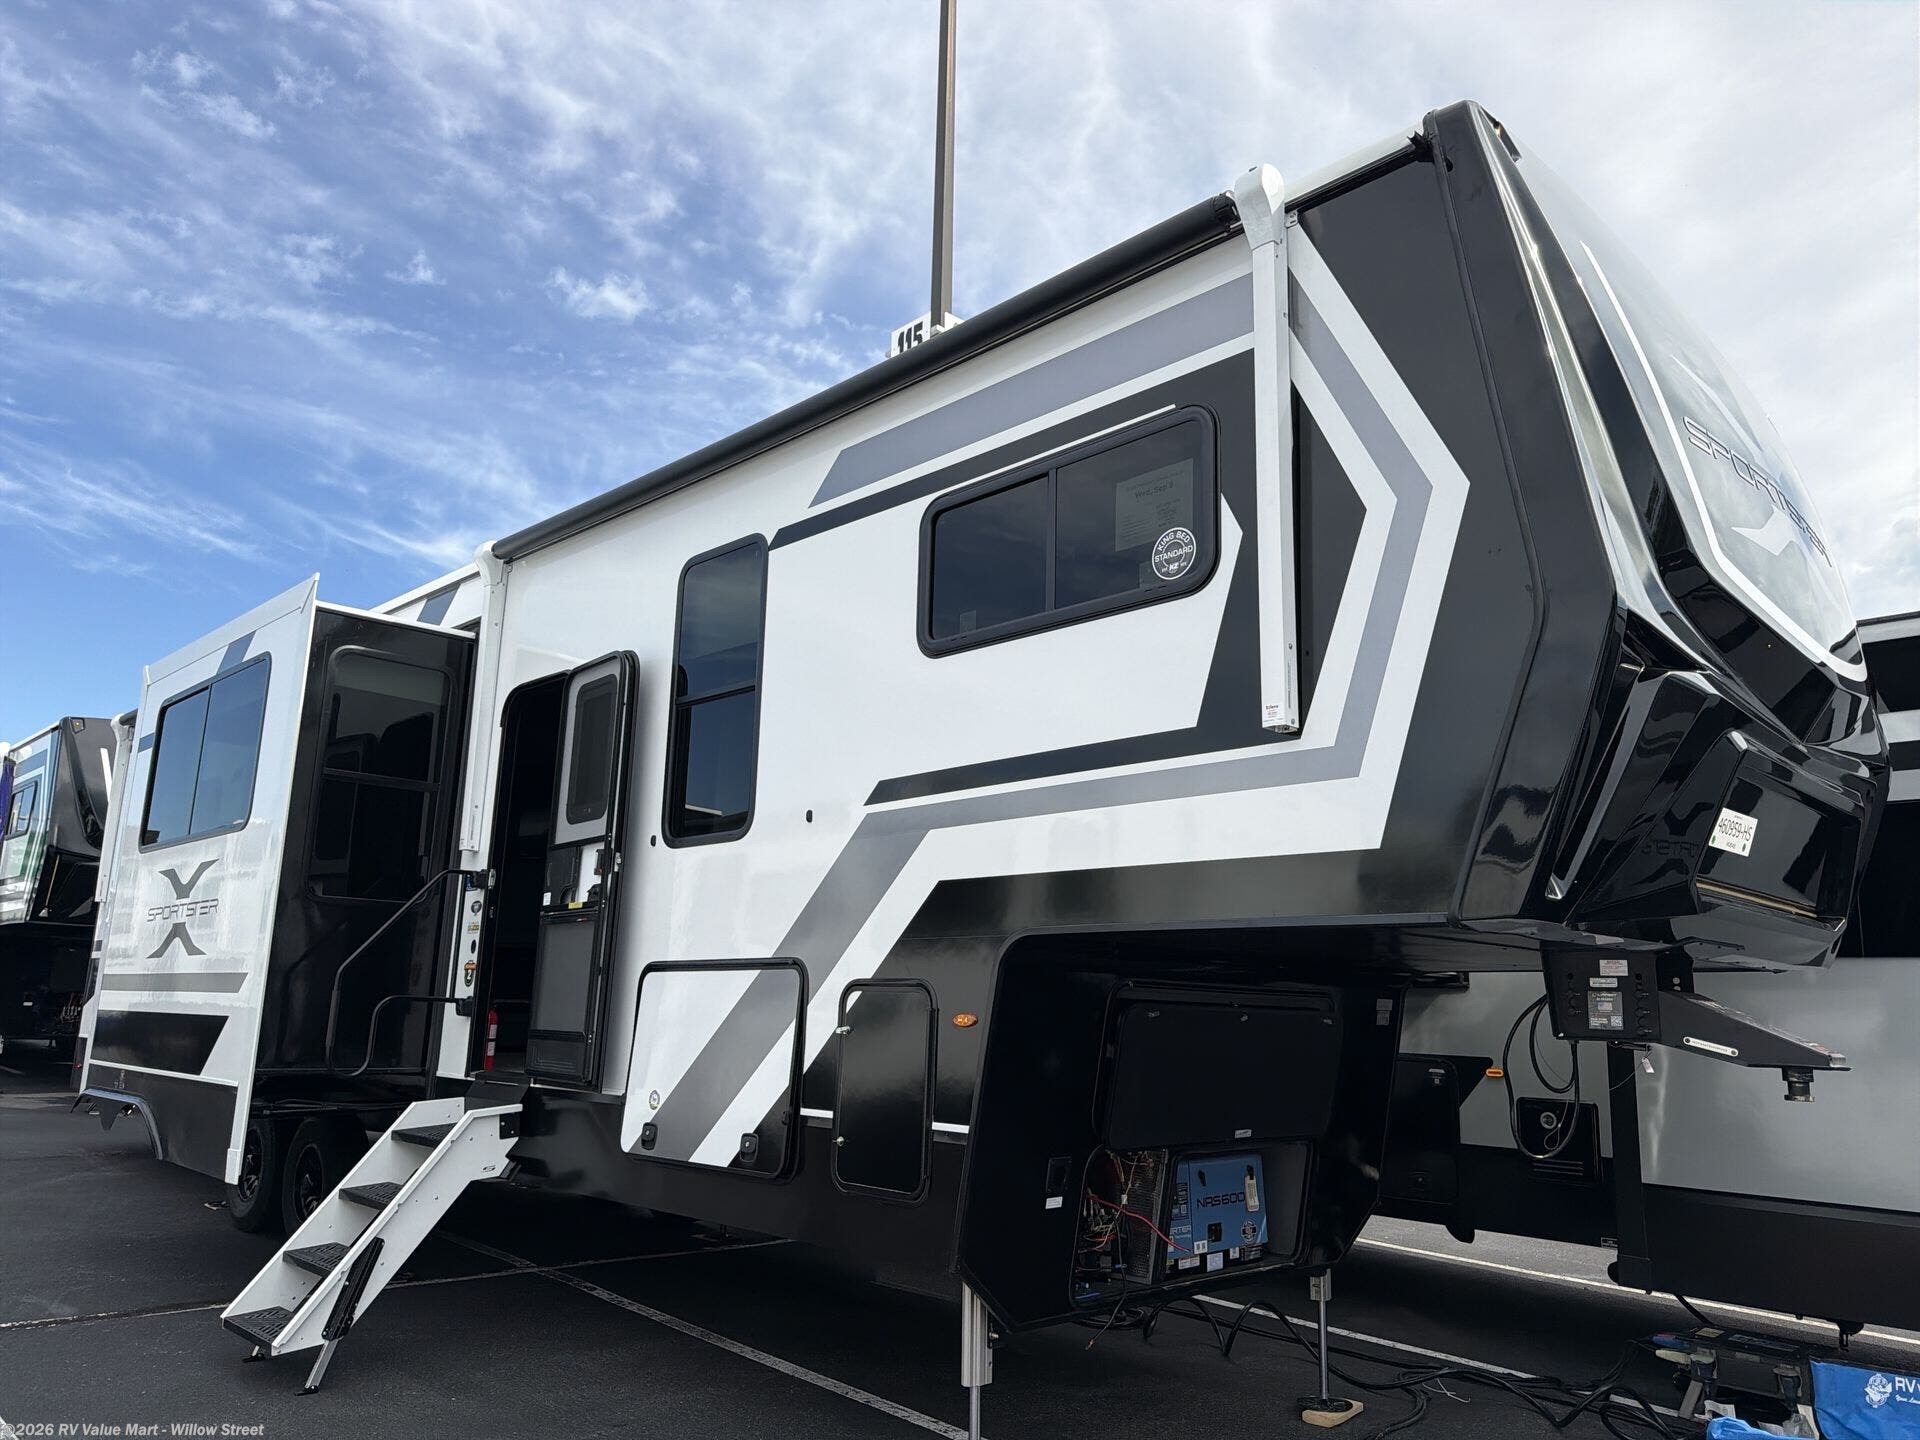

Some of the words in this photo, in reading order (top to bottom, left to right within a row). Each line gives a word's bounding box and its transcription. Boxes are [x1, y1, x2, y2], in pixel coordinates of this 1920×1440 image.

[897, 321, 924, 354] 115
[1157, 532, 1175, 551] KING
[1176, 530, 1191, 543] BED
[1154, 544, 1194, 563] STANDARD
[146, 898, 219, 922] SPORTSTER
